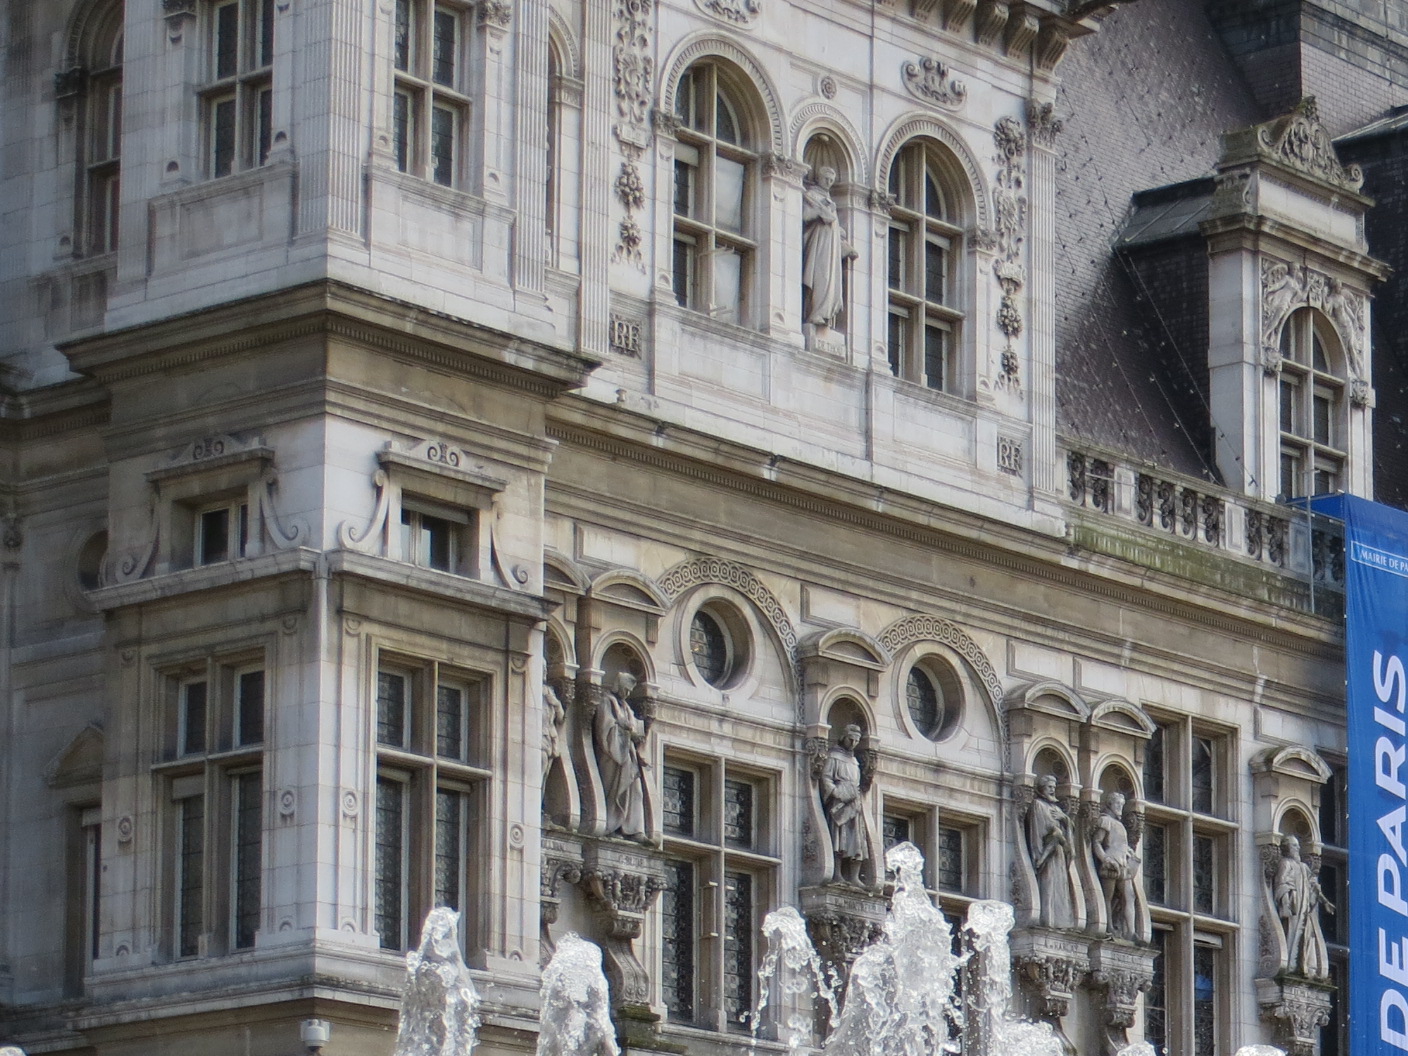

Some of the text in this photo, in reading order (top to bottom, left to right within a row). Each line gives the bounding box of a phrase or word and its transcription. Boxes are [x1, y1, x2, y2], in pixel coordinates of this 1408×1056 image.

[1360, 550, 1387, 567] MAIRIE
[1388, 558, 1400, 570] DE
[1372, 649, 1408, 918] PARIS
